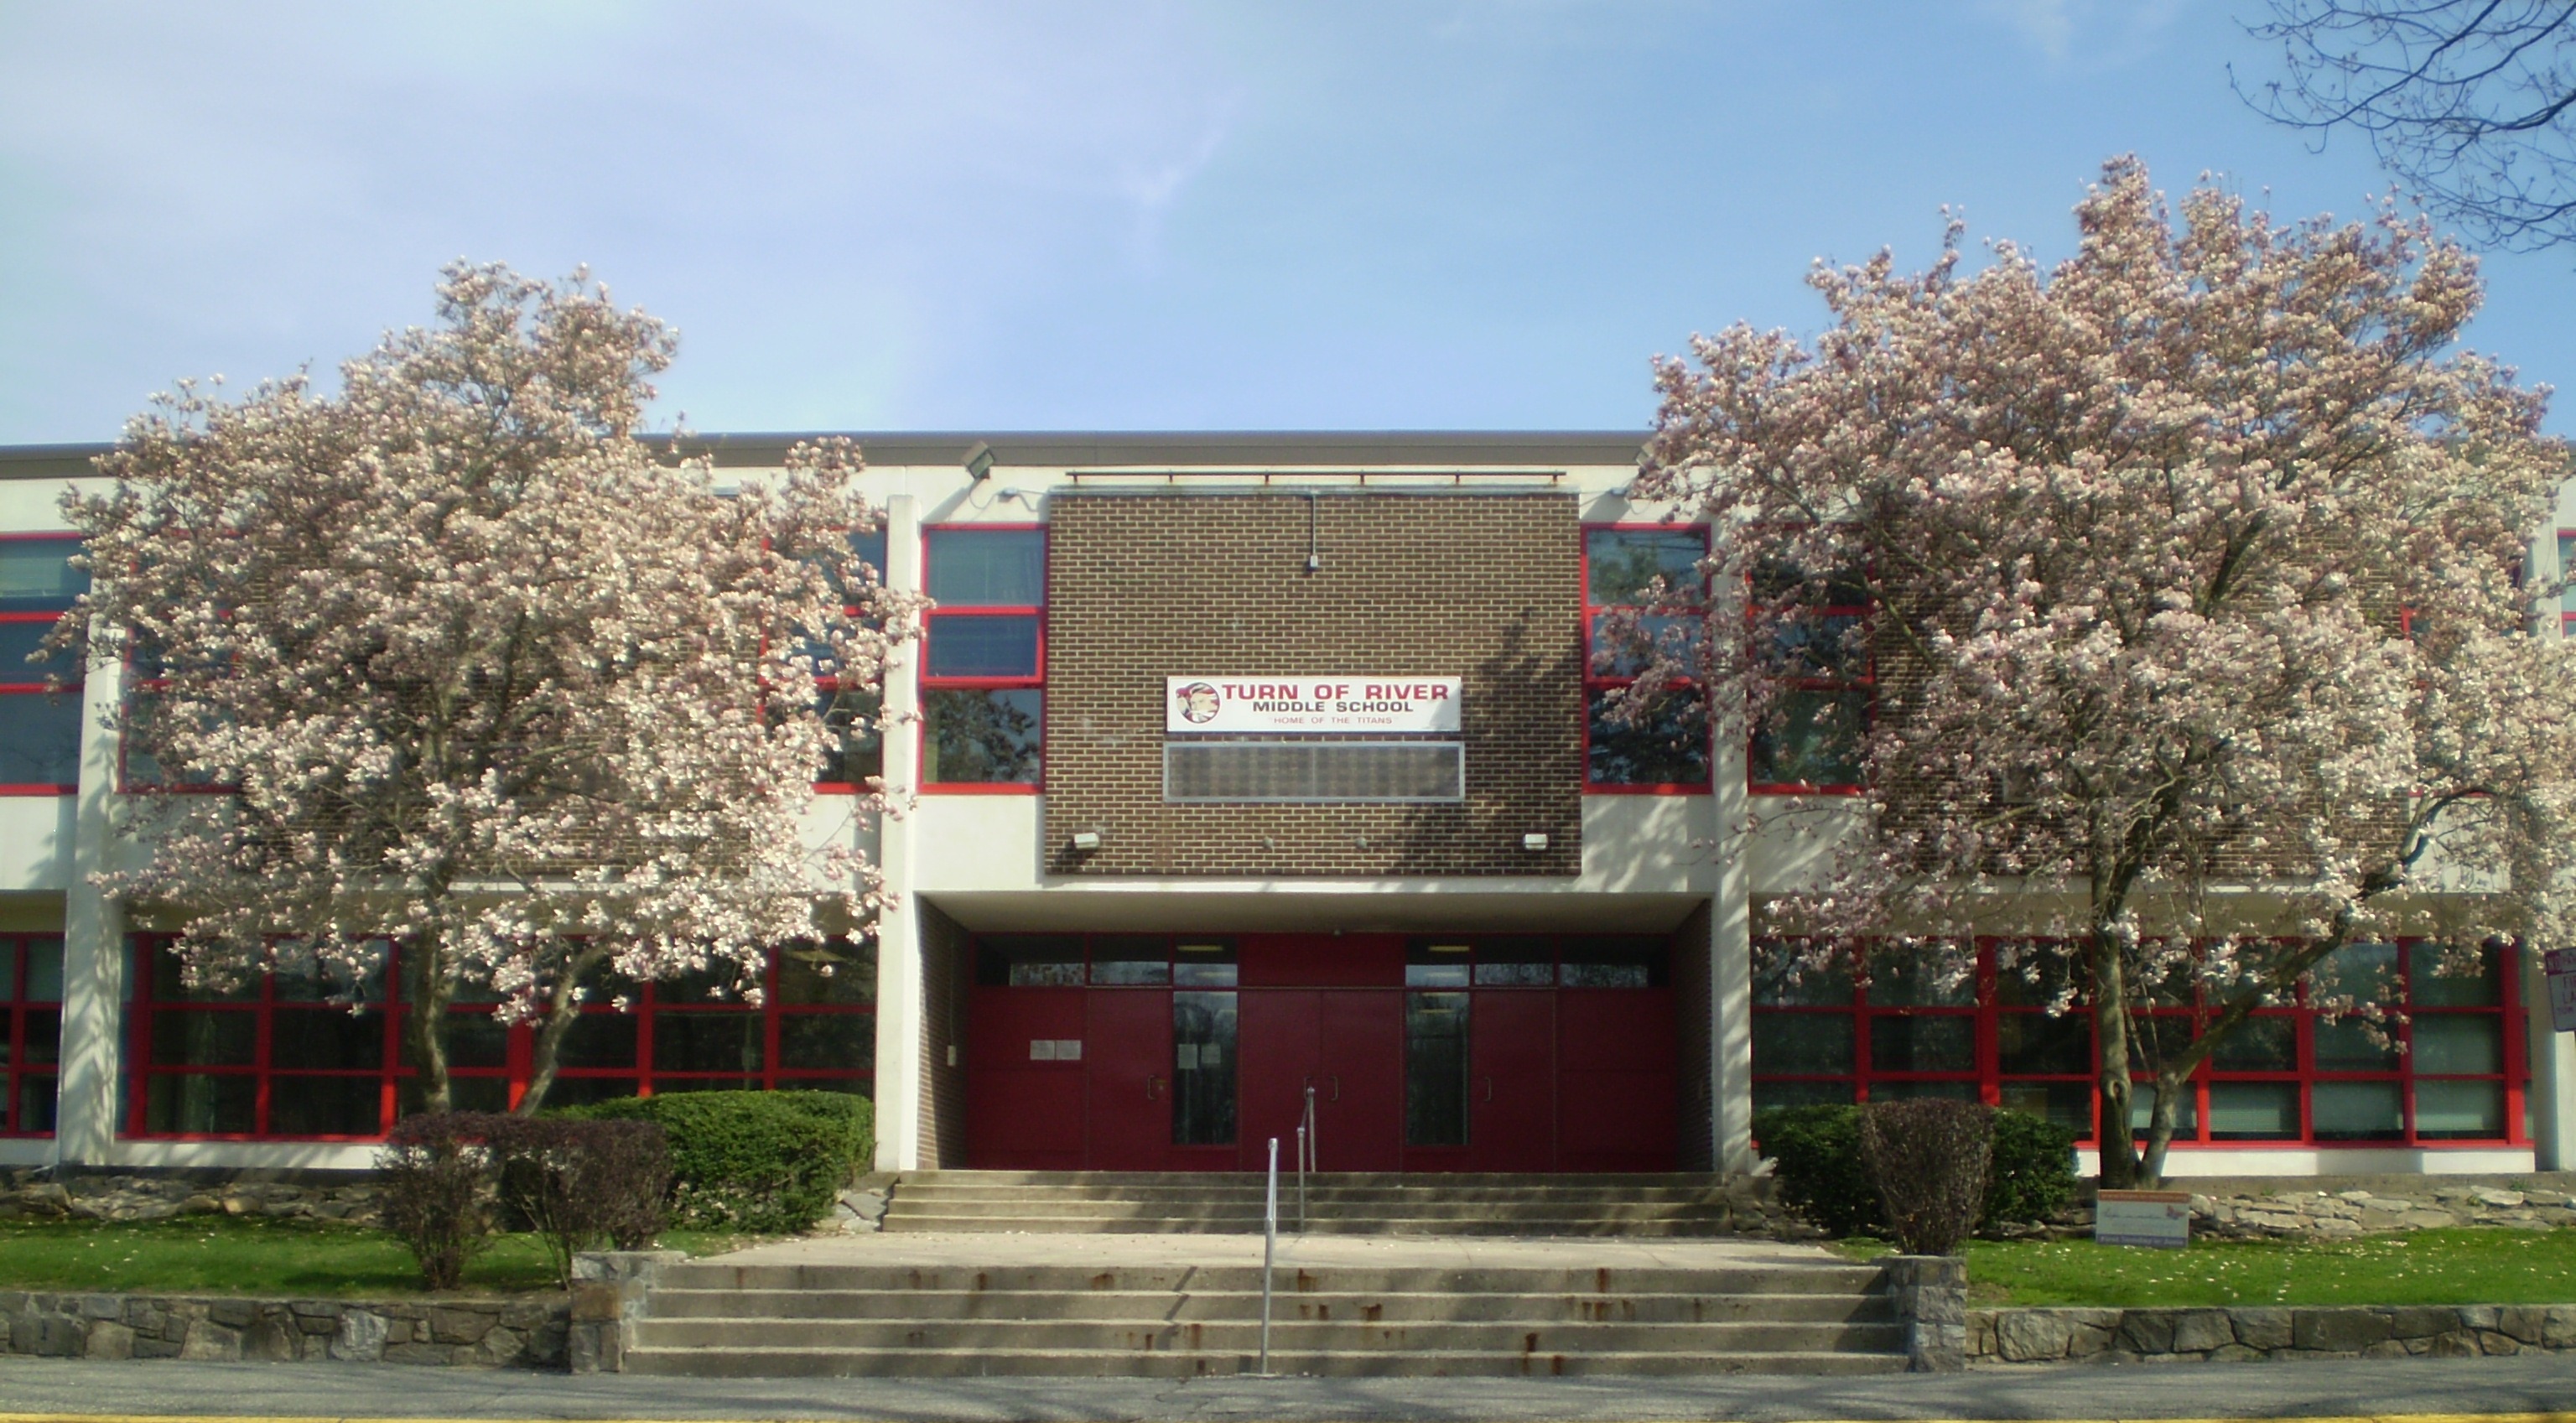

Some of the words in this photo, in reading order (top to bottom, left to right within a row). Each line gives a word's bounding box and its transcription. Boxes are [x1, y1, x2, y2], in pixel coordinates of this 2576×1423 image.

[1222, 684, 1298, 700] TURN
[1314, 684, 1349, 700] OF
[1365, 684, 1448, 700] RIVER
[1253, 701, 1325, 713] MIDDLE
[1336, 701, 1414, 713] SCHOOL
[1357, 716, 1393, 724] TITANS
